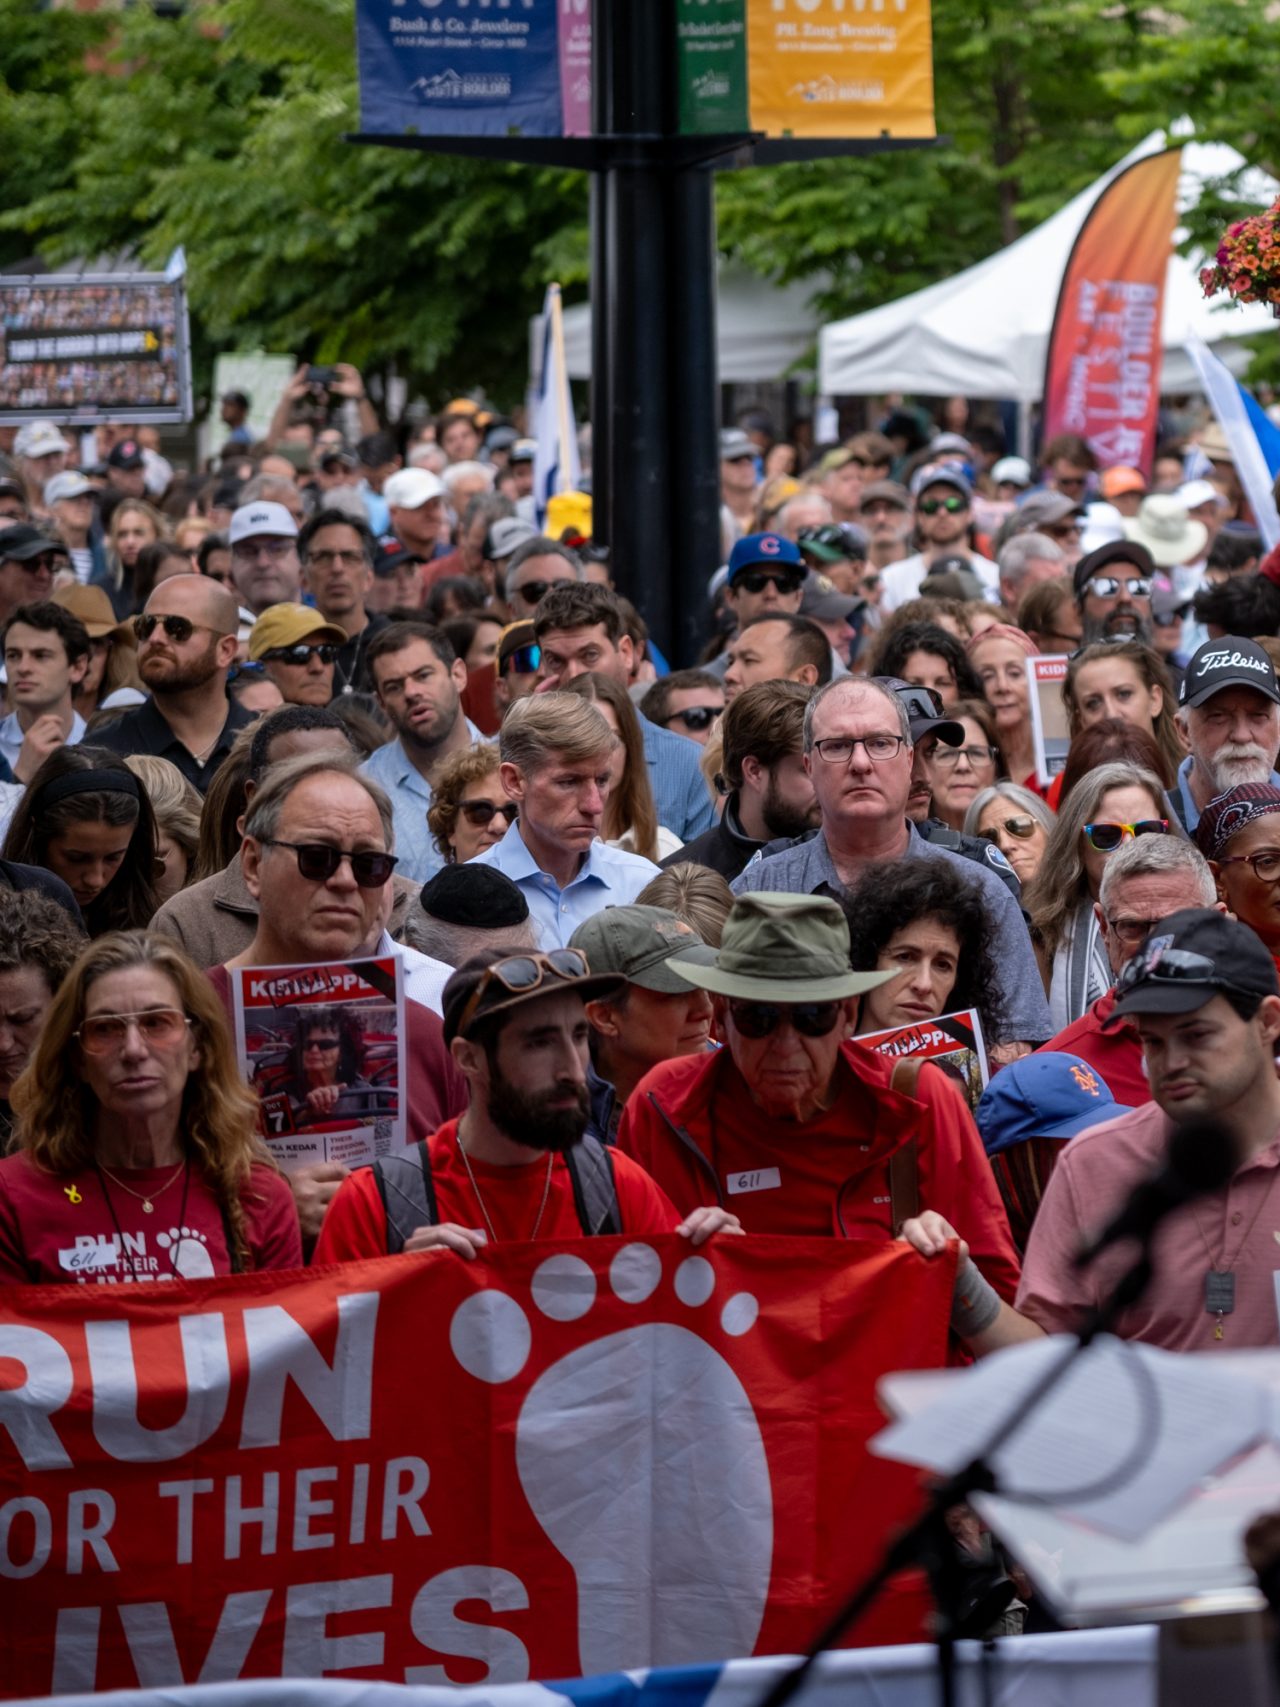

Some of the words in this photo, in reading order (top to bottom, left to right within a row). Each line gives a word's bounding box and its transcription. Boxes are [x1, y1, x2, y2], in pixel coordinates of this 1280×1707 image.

[389, 17, 428, 33] Bush
[469, 18, 529, 33] Jewelers
[1197, 650, 1269, 676] Titleist
[265, 1101, 282, 1110] OCT
[269, 1110, 285, 1133] 7
[286, 1143, 317, 1151] KEDAR
[331, 1152, 347, 1161] OUR
[738, 1173, 760, 1189] 611
[70, 1252, 97, 1267] 611
[115, 1256, 160, 1272] THEIR
[0, 1487, 121, 1580] OR
[158, 1456, 433, 1565] THEIR
[51, 1565, 530, 1697] IVES
